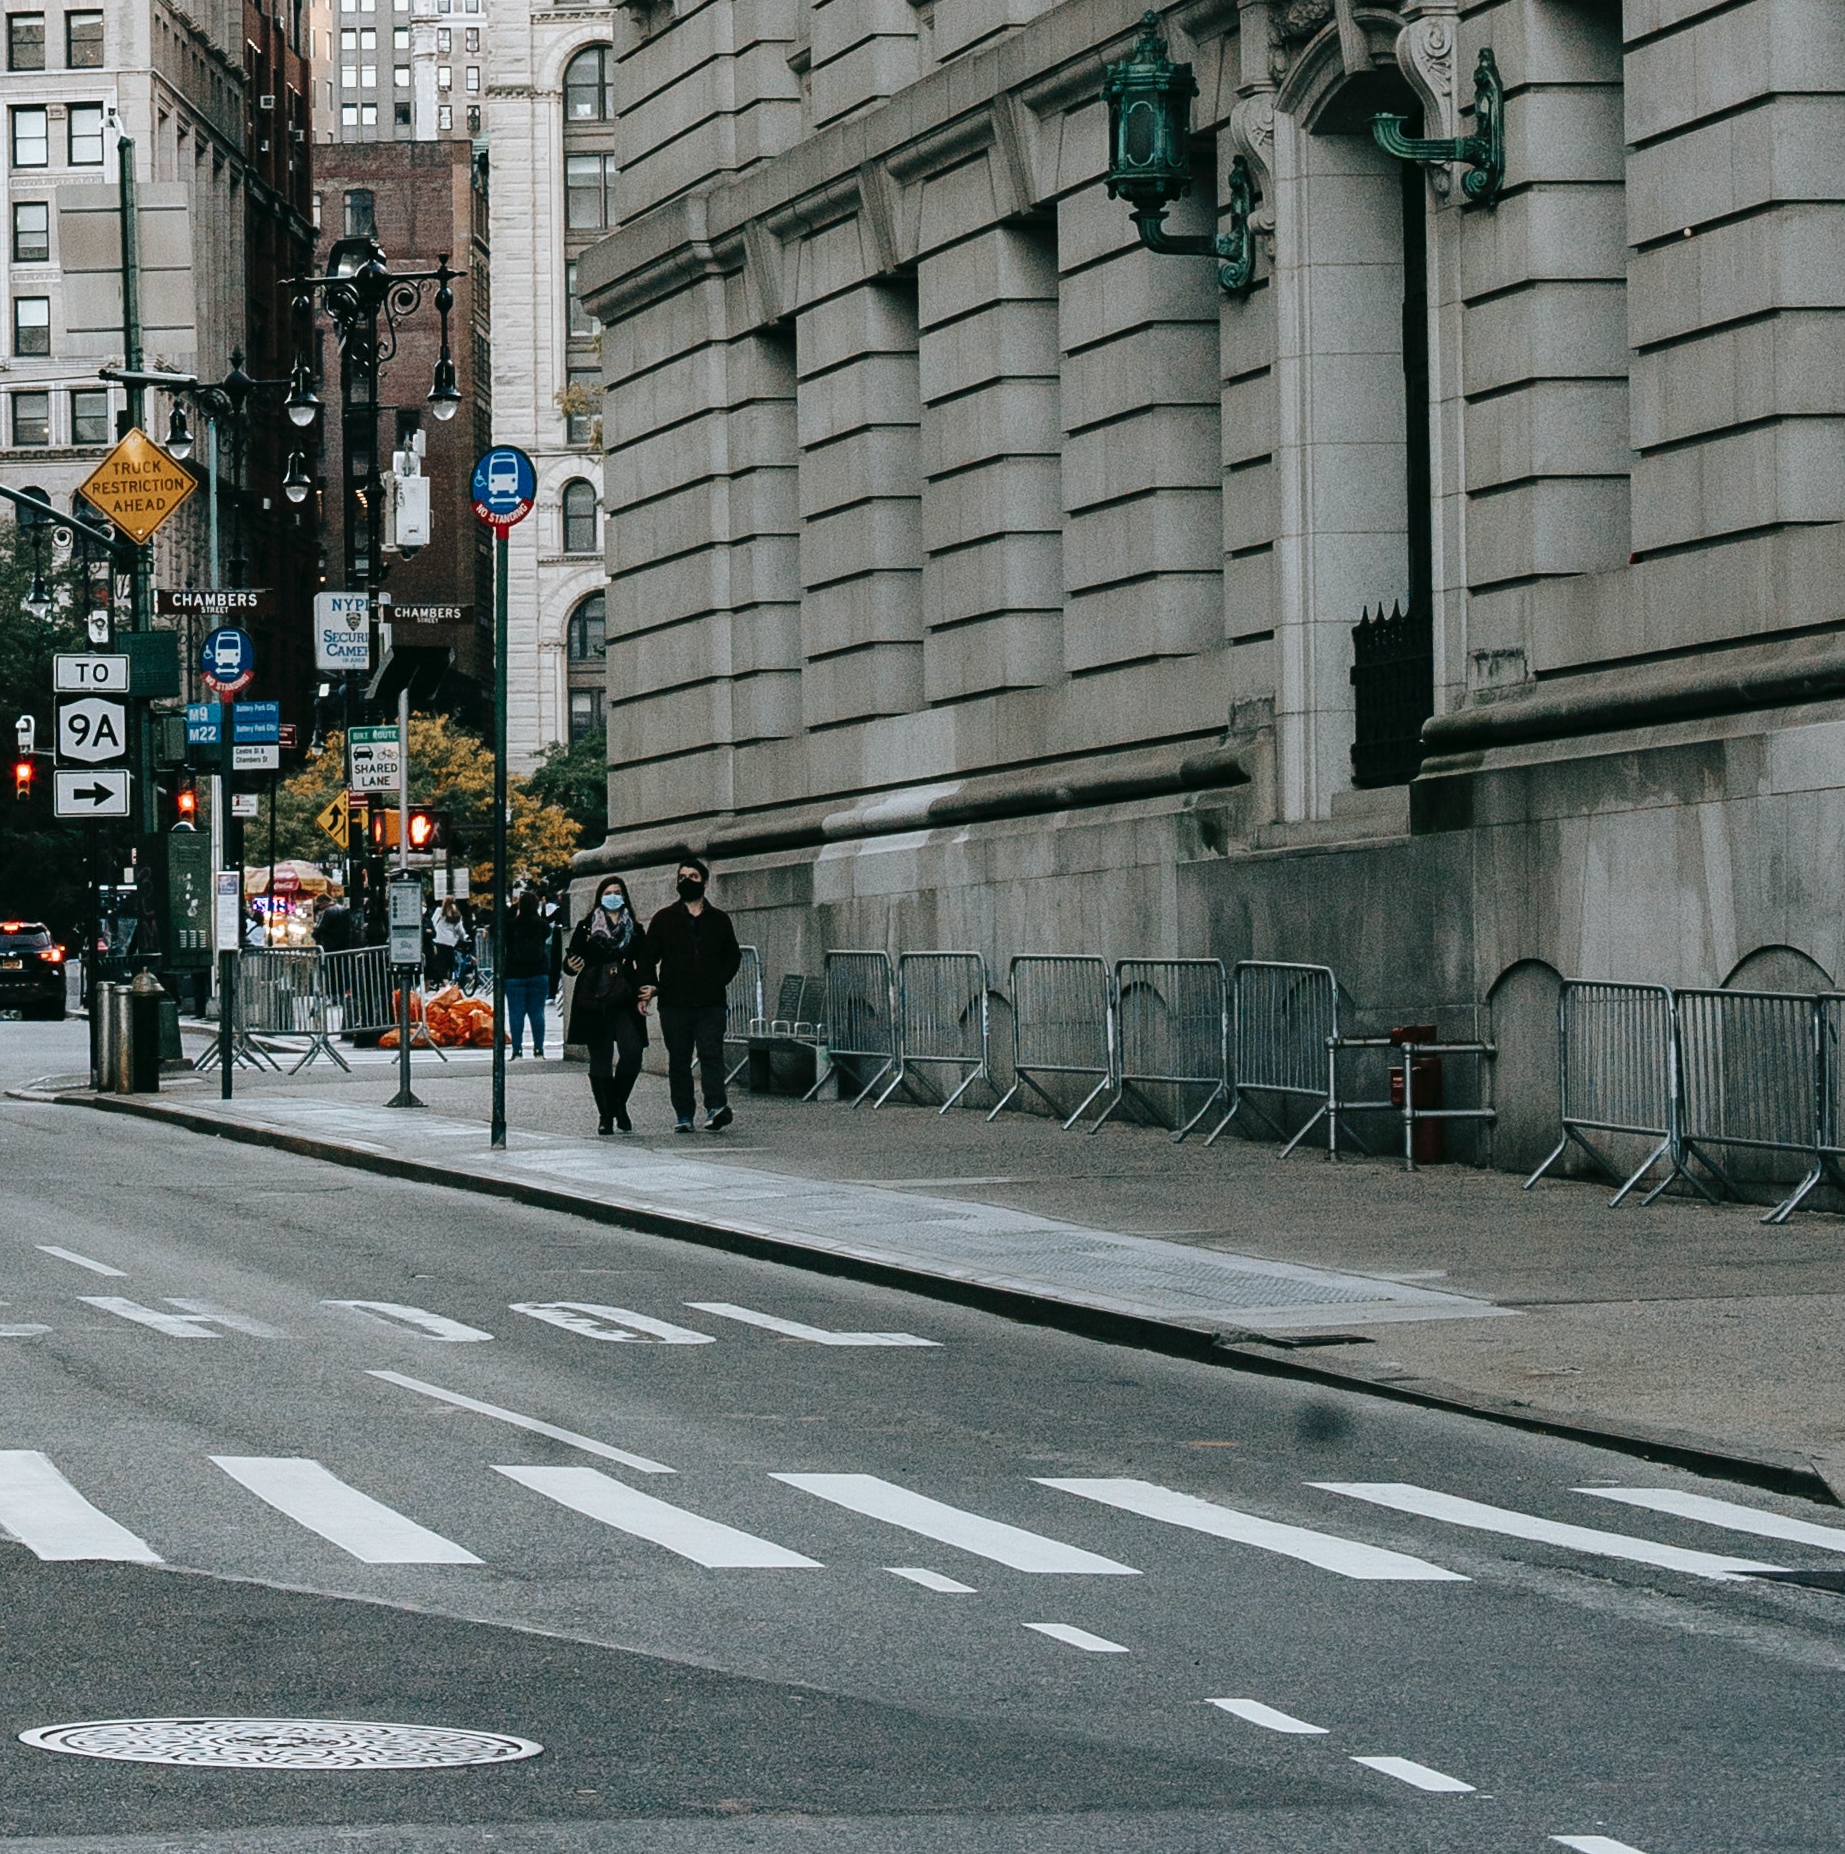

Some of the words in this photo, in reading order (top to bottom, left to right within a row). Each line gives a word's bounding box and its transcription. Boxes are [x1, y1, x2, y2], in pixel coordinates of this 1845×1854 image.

[112, 460, 162, 475] TRUCK
[92, 478, 185, 495] RESTRICTION
[114, 498, 166, 512] AHEAD
[475, 504, 488, 517] NO
[488, 503, 528, 524] STANDING
[172, 593, 258, 607] CHAMBERS
[201, 606, 229, 614] STREET
[394, 607, 461, 618] CHAMBERS
[323, 630, 368, 643] SECURI
[326, 643, 368, 657] CAME
[75, 663, 109, 683] TO
[205, 674, 216, 686] NO
[189, 706, 208, 722] M9
[236, 705, 253, 713] Battery
[266, 704, 276, 712] City
[68, 713, 119, 747] 9A
[189, 726, 217, 741] M22
[236, 725, 254, 733] Battery
[266, 724, 276, 732] City
[353, 732, 368, 740] BIKE
[372, 730, 397, 739] ROUTE
[354, 763, 398, 774] SHARED
[362, 776, 391, 787] LANE
